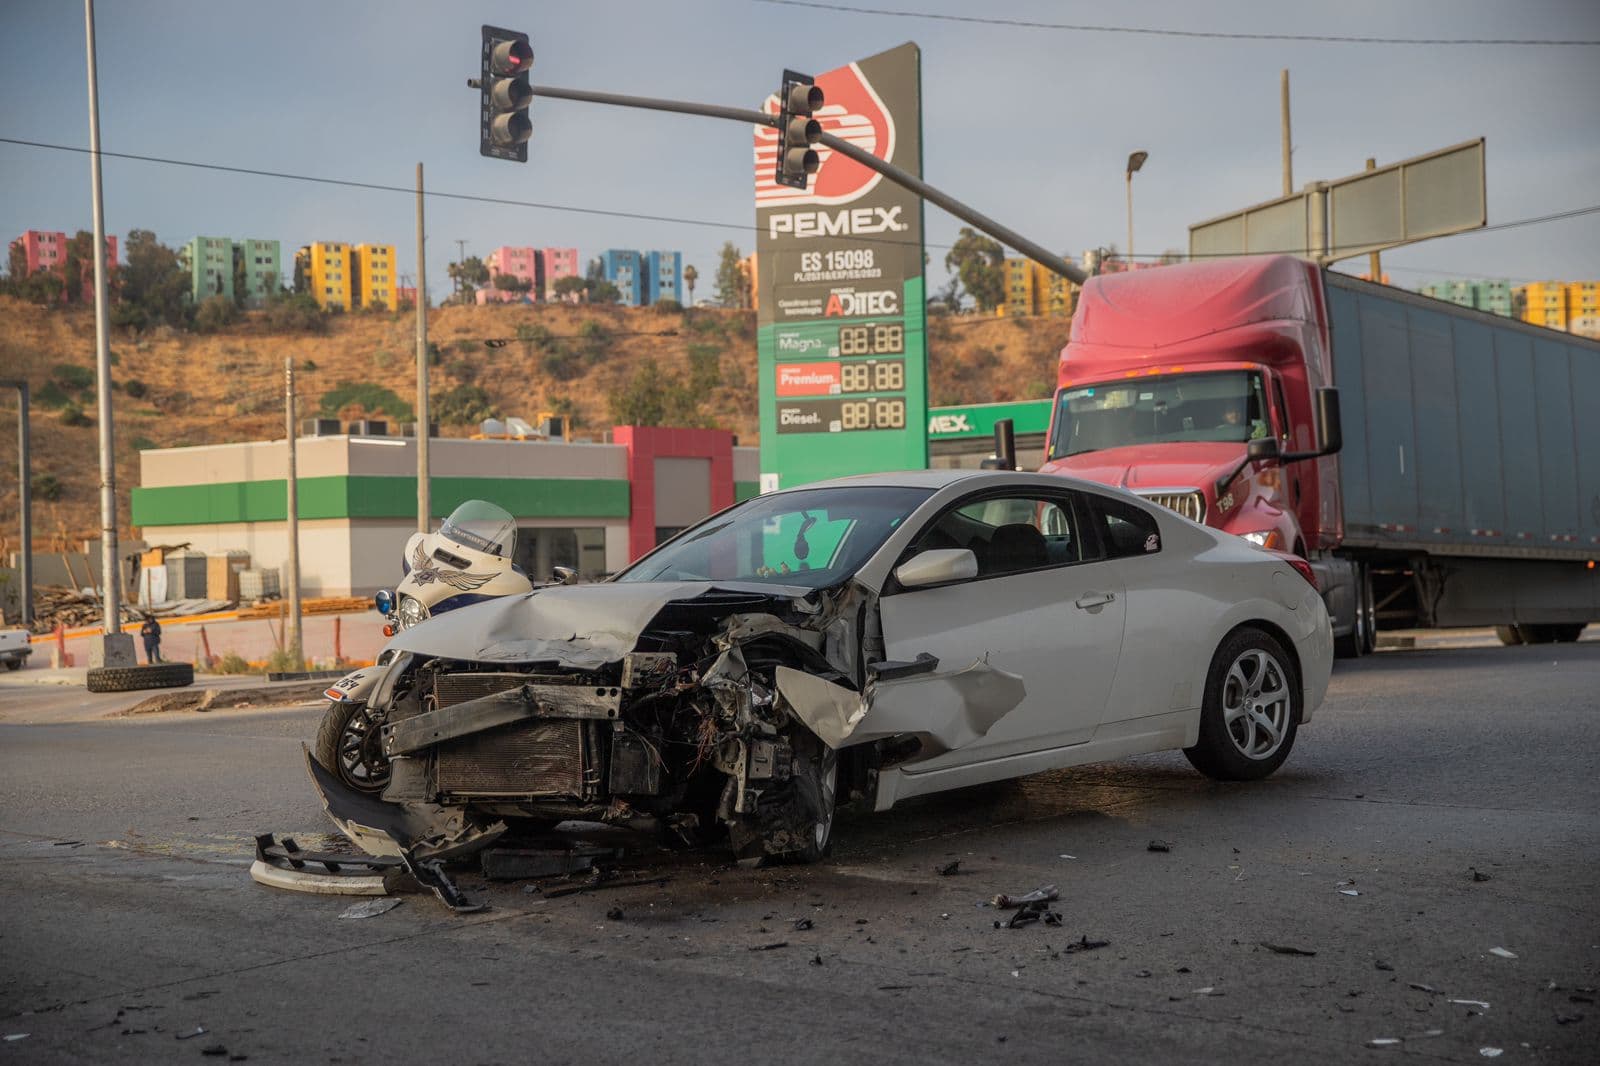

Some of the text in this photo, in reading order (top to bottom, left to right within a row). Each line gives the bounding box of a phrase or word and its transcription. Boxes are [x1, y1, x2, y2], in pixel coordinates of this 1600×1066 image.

[769, 206, 903, 240] PEMEX
[801, 249, 875, 273] ES 15098
[779, 337, 822, 353] Magna
[780, 371, 834, 386] Premium
[780, 412, 818, 425] Diesel
[928, 413, 970, 433] MEX
[1216, 493, 1233, 514] T98
